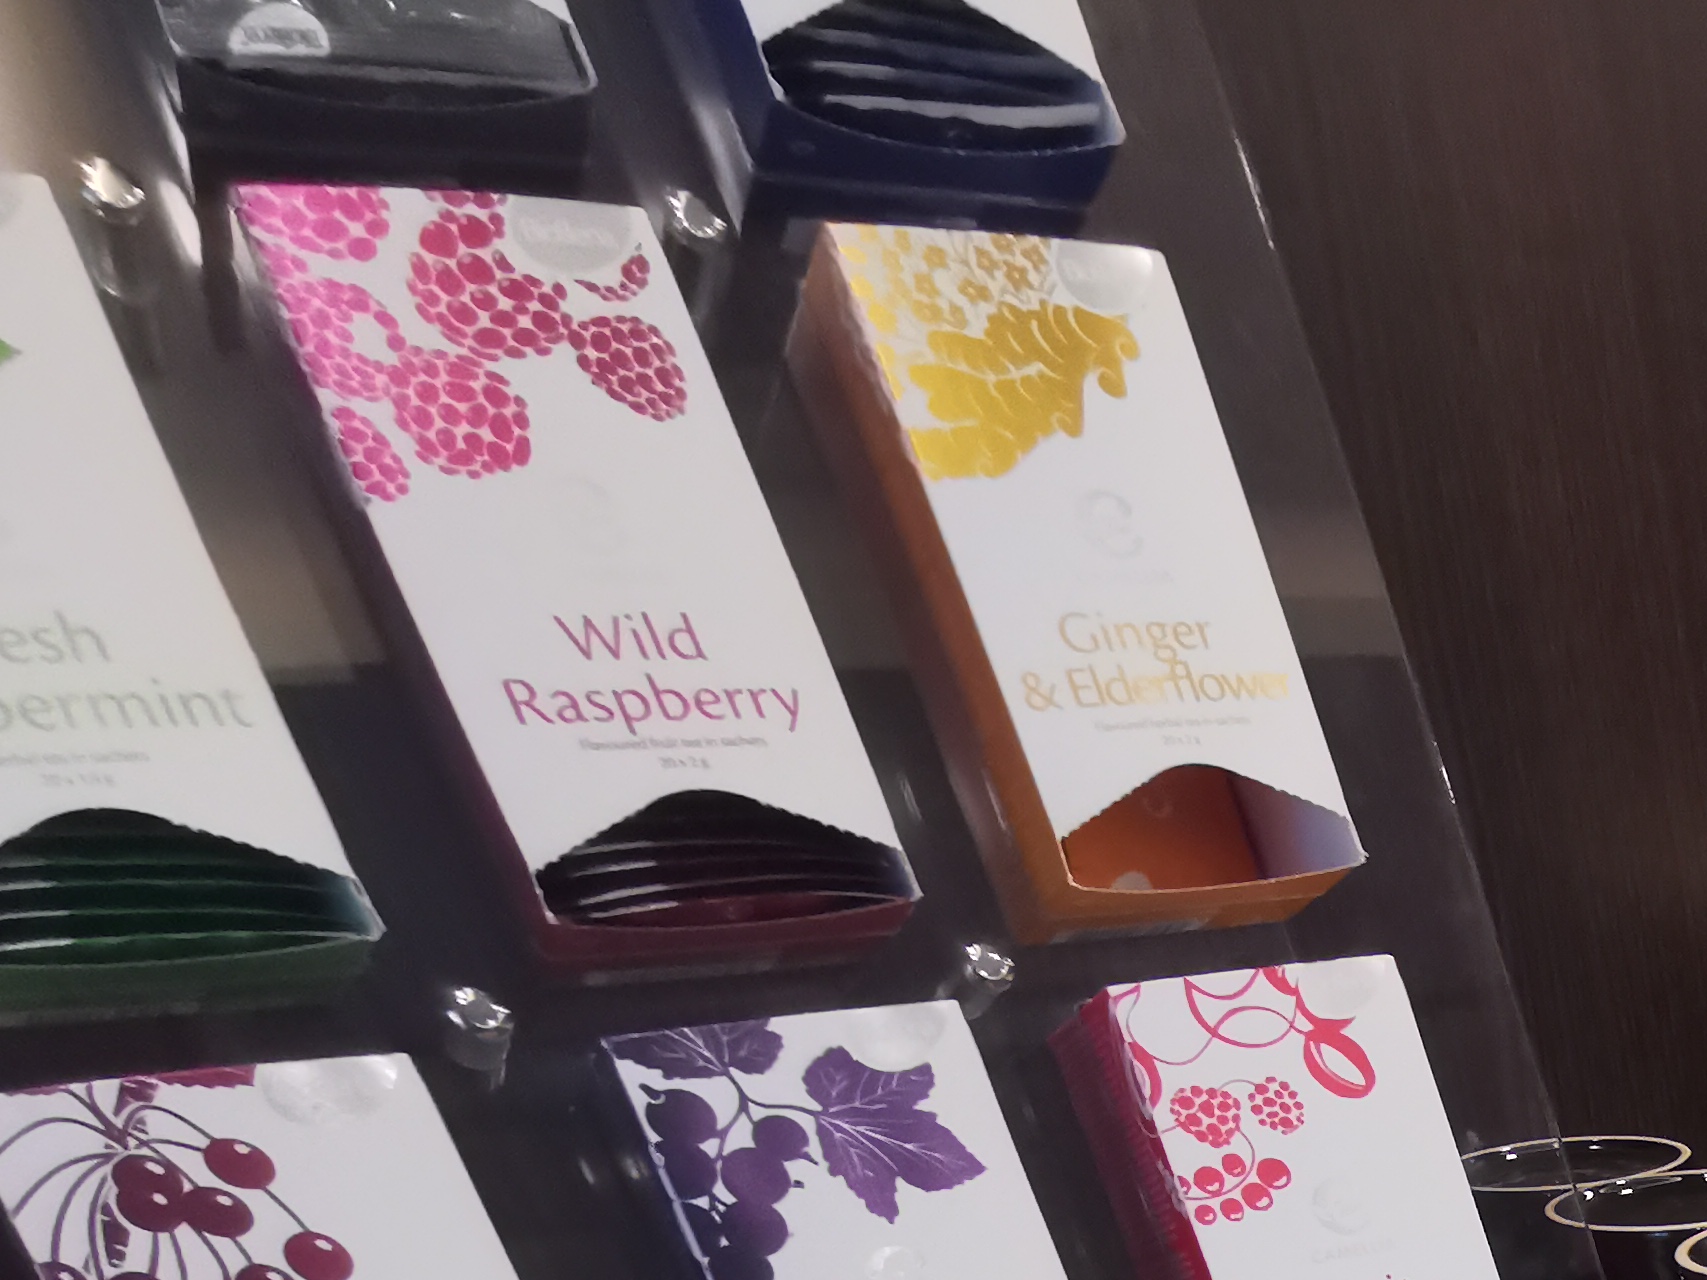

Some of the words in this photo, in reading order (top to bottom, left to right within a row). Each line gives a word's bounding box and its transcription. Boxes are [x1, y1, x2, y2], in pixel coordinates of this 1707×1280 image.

[553, 611, 709, 661] Wild
[1058, 611, 1211, 663] Ginger
[501, 673, 800, 736] Raspberry
[1021, 671, 1064, 712] &
[1065, 660, 1290, 708] Elderflower
